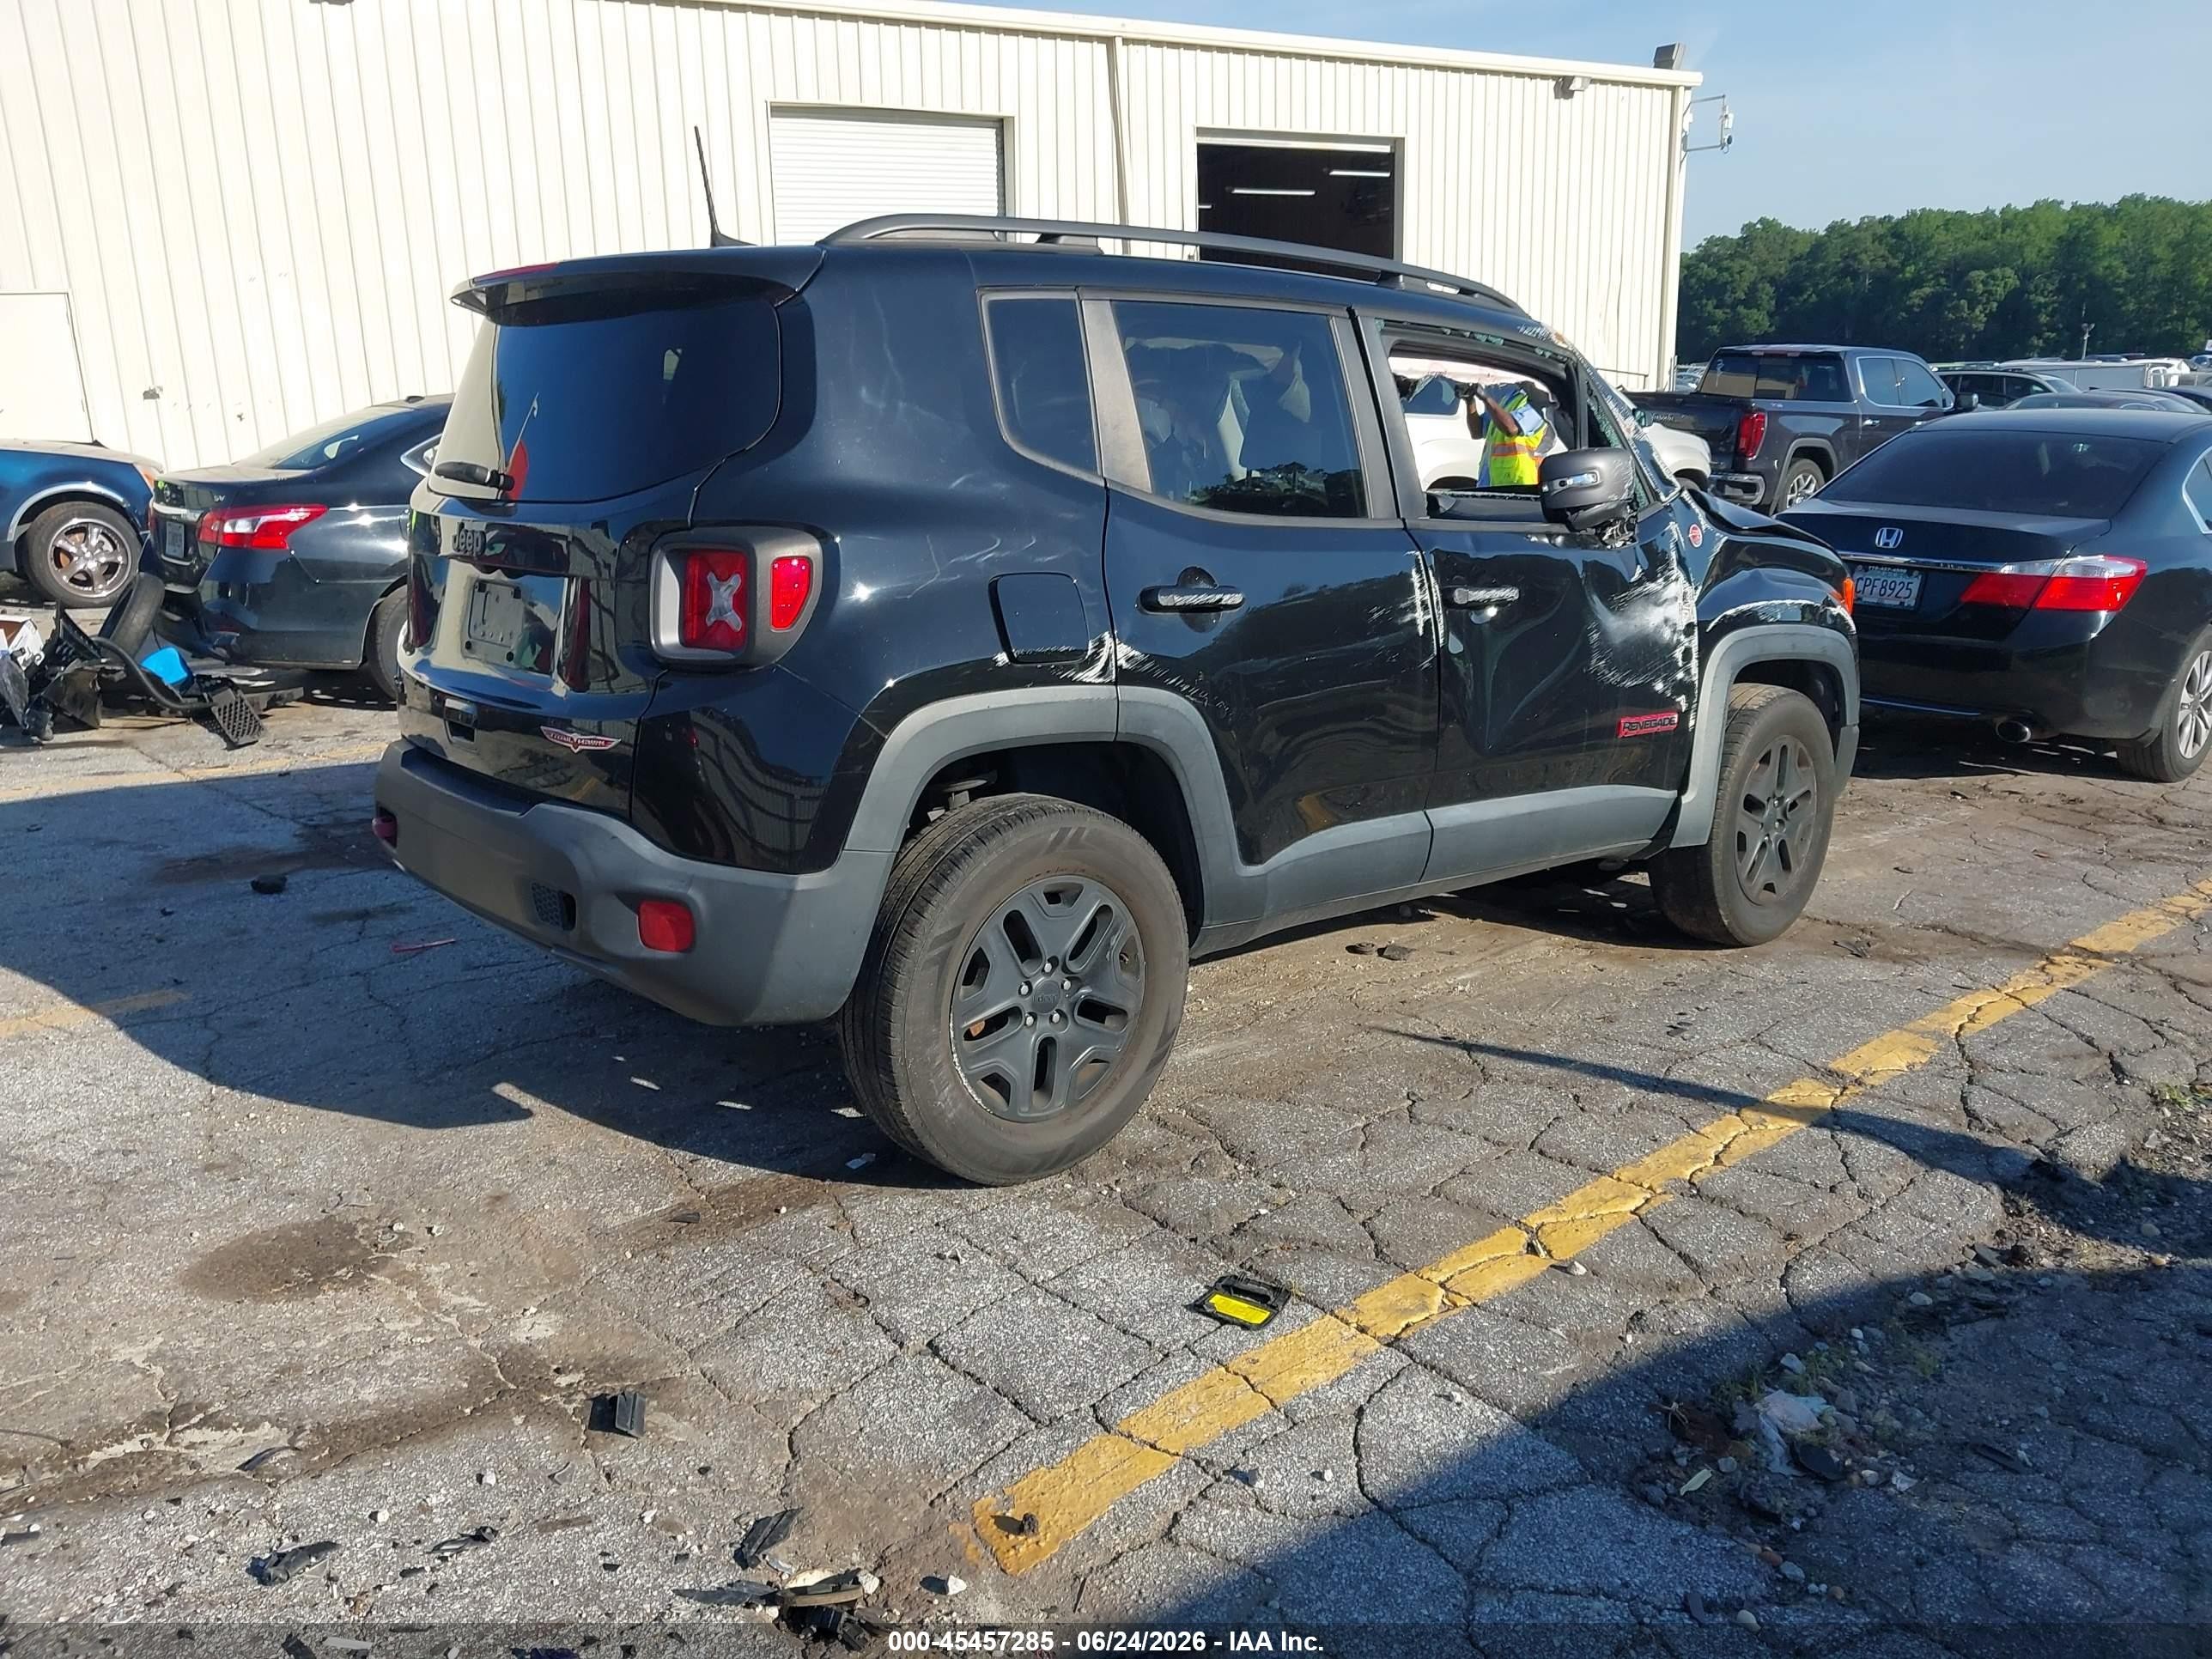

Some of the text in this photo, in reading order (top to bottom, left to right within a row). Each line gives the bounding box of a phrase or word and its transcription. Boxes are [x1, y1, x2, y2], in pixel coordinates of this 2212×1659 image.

[452, 521, 486, 557] Jeep
[1855, 576, 1914, 599] CPF8925
[1623, 716, 1676, 731] RENEGADE
